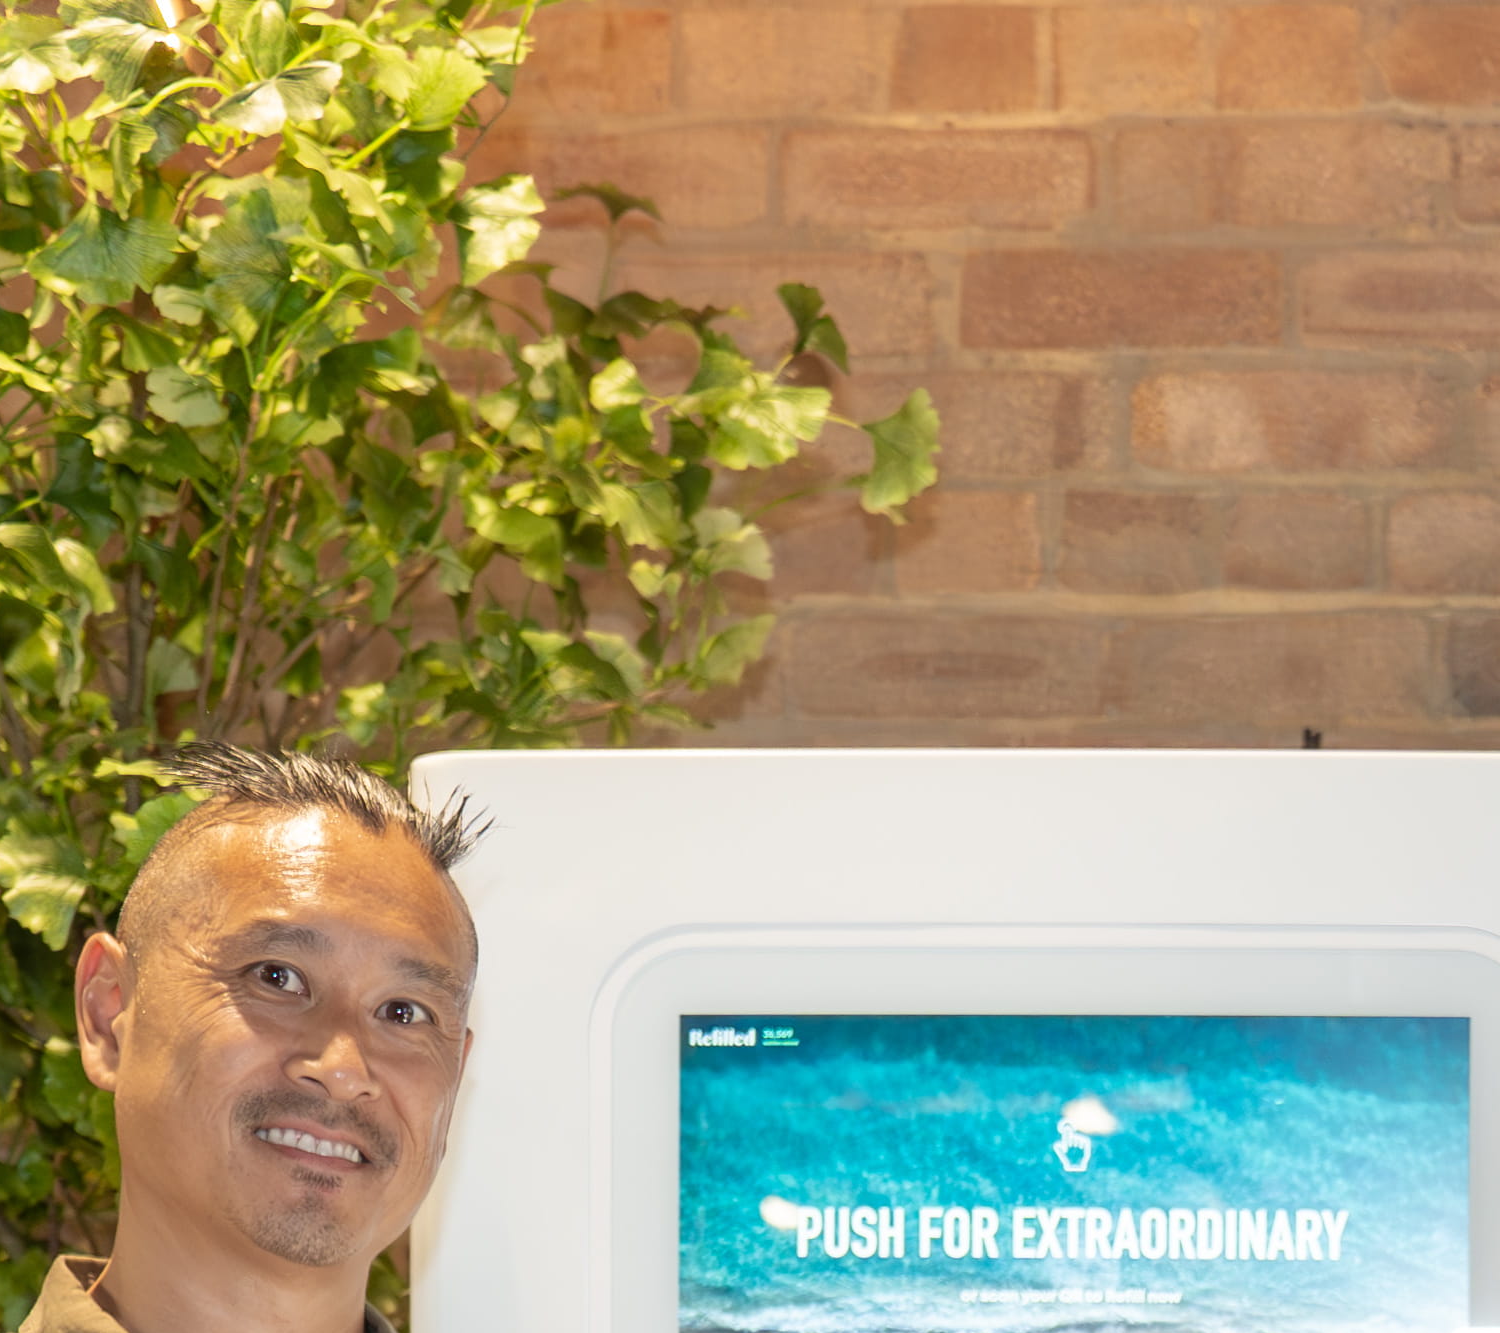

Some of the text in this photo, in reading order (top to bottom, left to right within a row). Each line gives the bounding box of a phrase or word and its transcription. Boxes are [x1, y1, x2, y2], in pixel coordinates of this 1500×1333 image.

[688, 1028, 756, 1047] Refilled
[797, 1206, 1349, 1261] PUSH FOR EXTRAORDINARY
